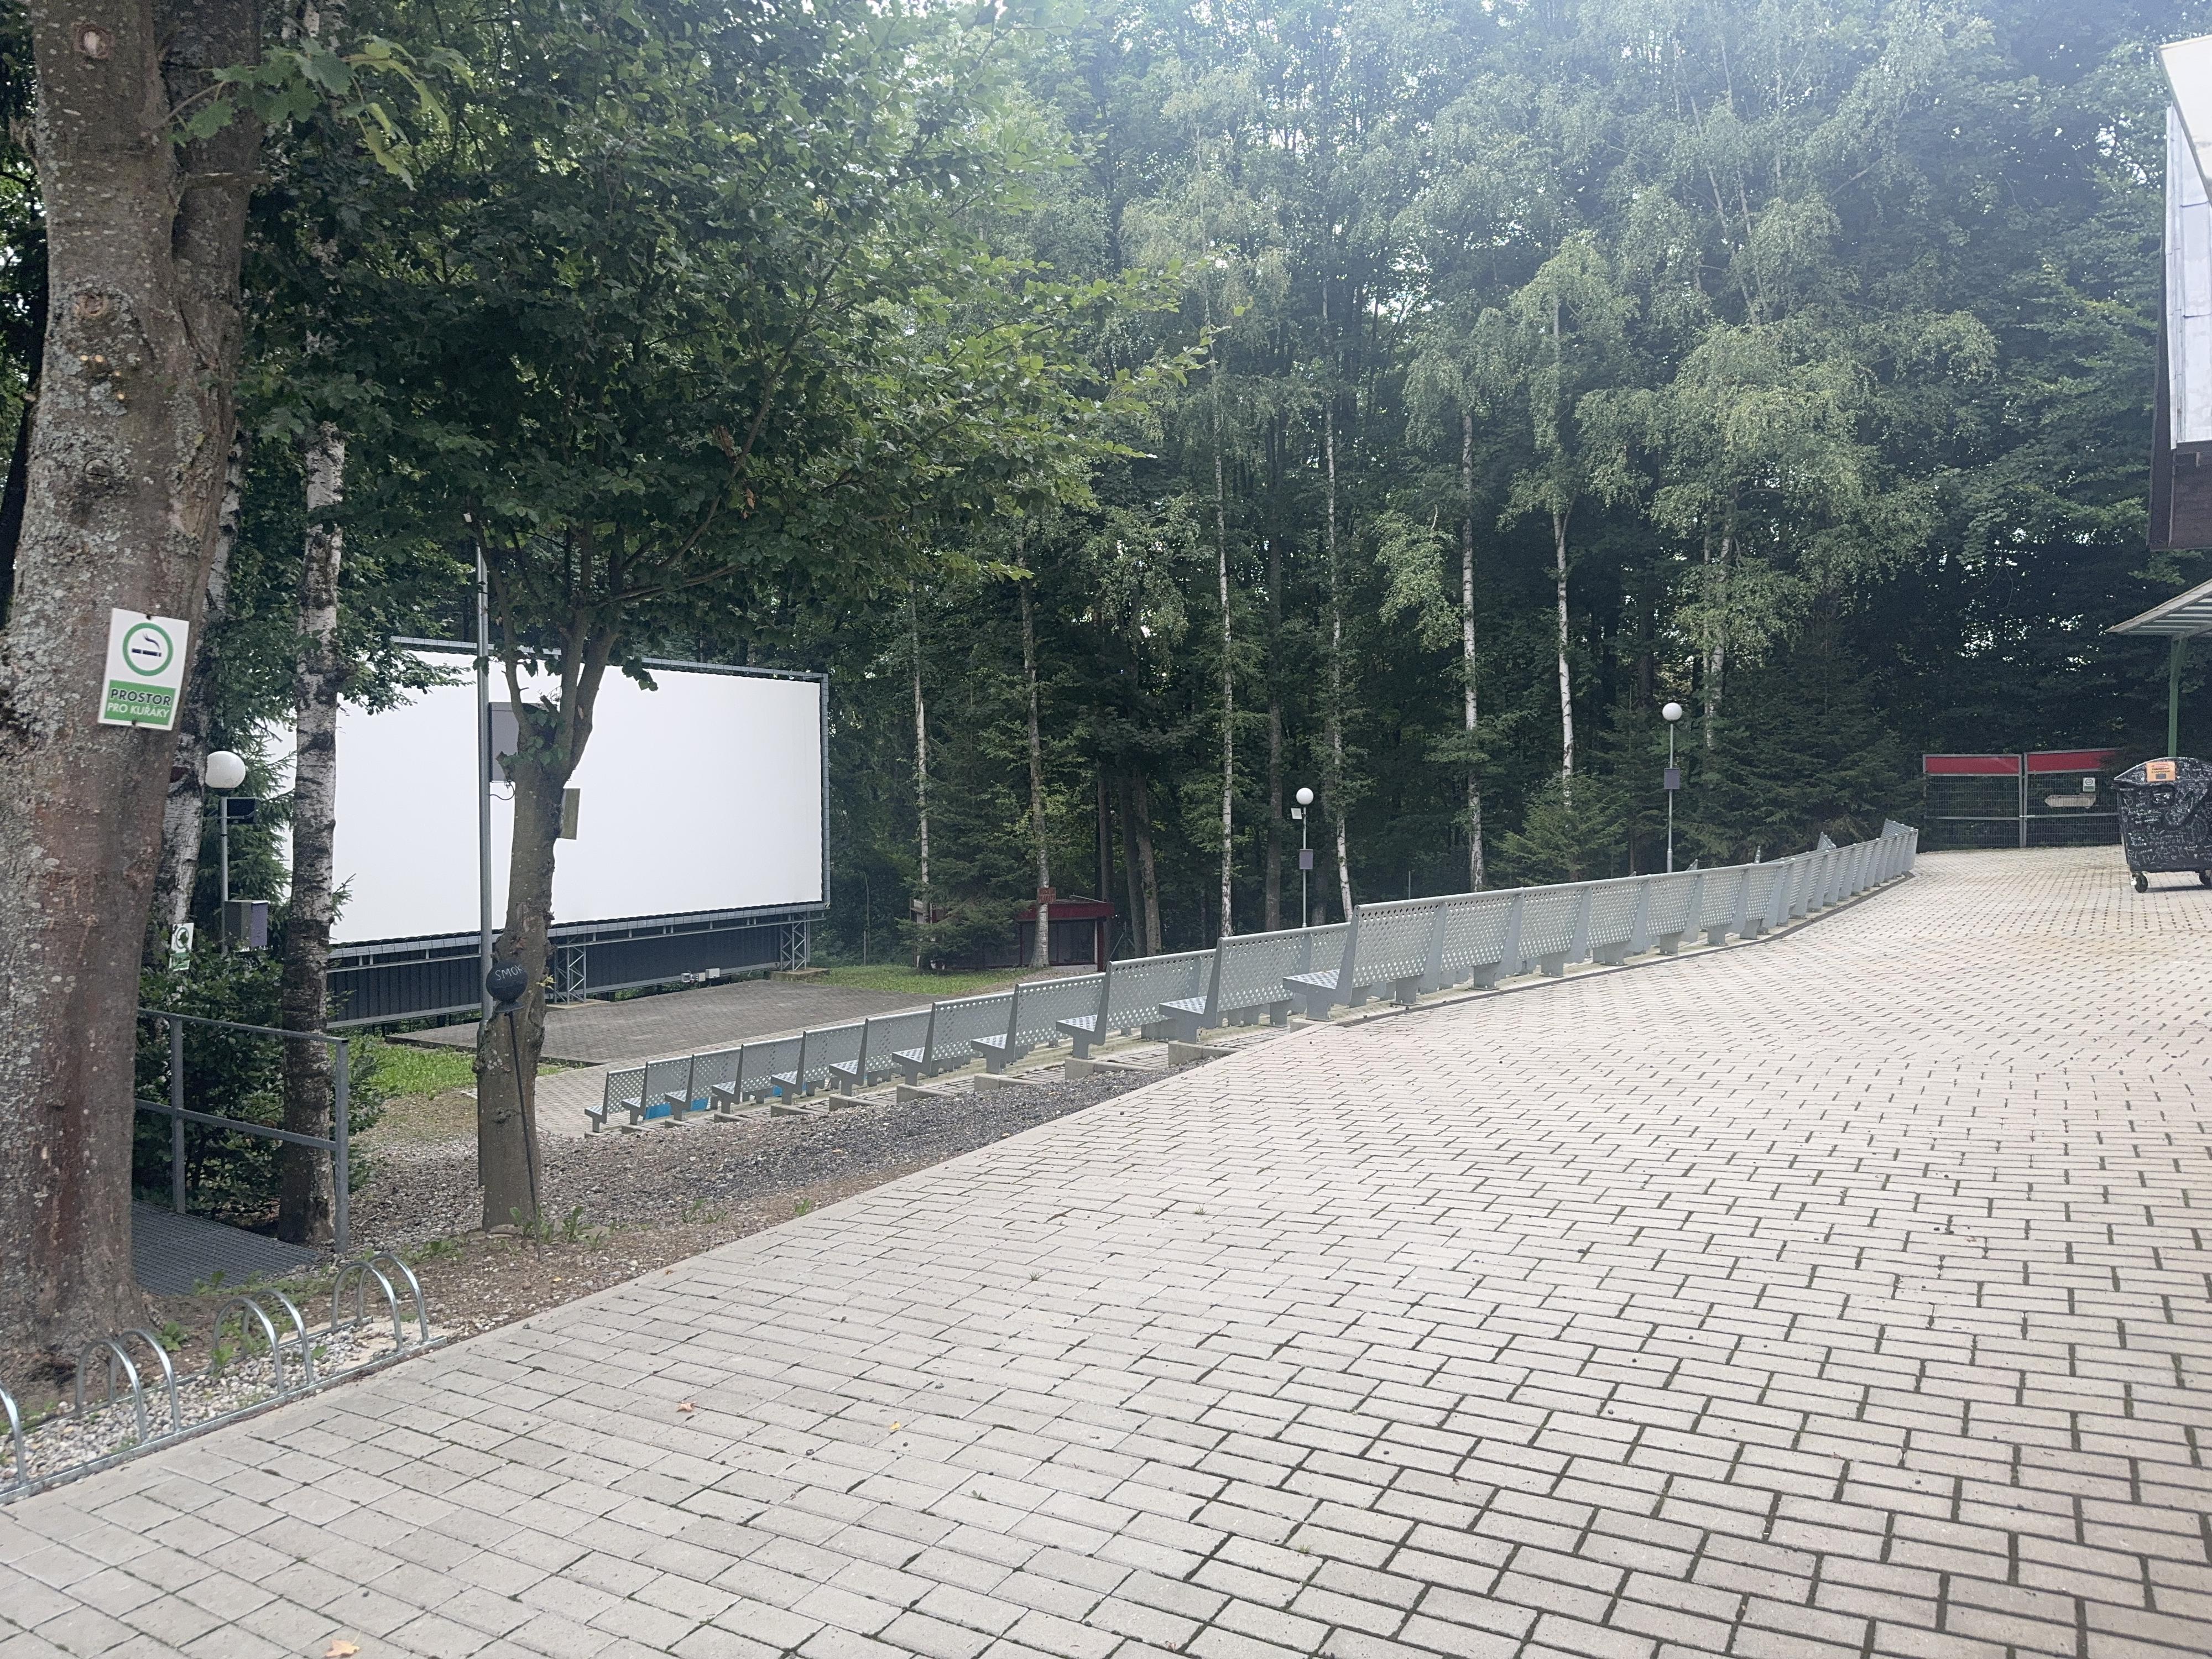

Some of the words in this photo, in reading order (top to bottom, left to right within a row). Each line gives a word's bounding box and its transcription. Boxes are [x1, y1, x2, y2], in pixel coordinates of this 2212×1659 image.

[110, 688, 171, 706] PROSTOR
[107, 702, 128, 713] PRO
[130, 704, 169, 718] KUŘÁKY
